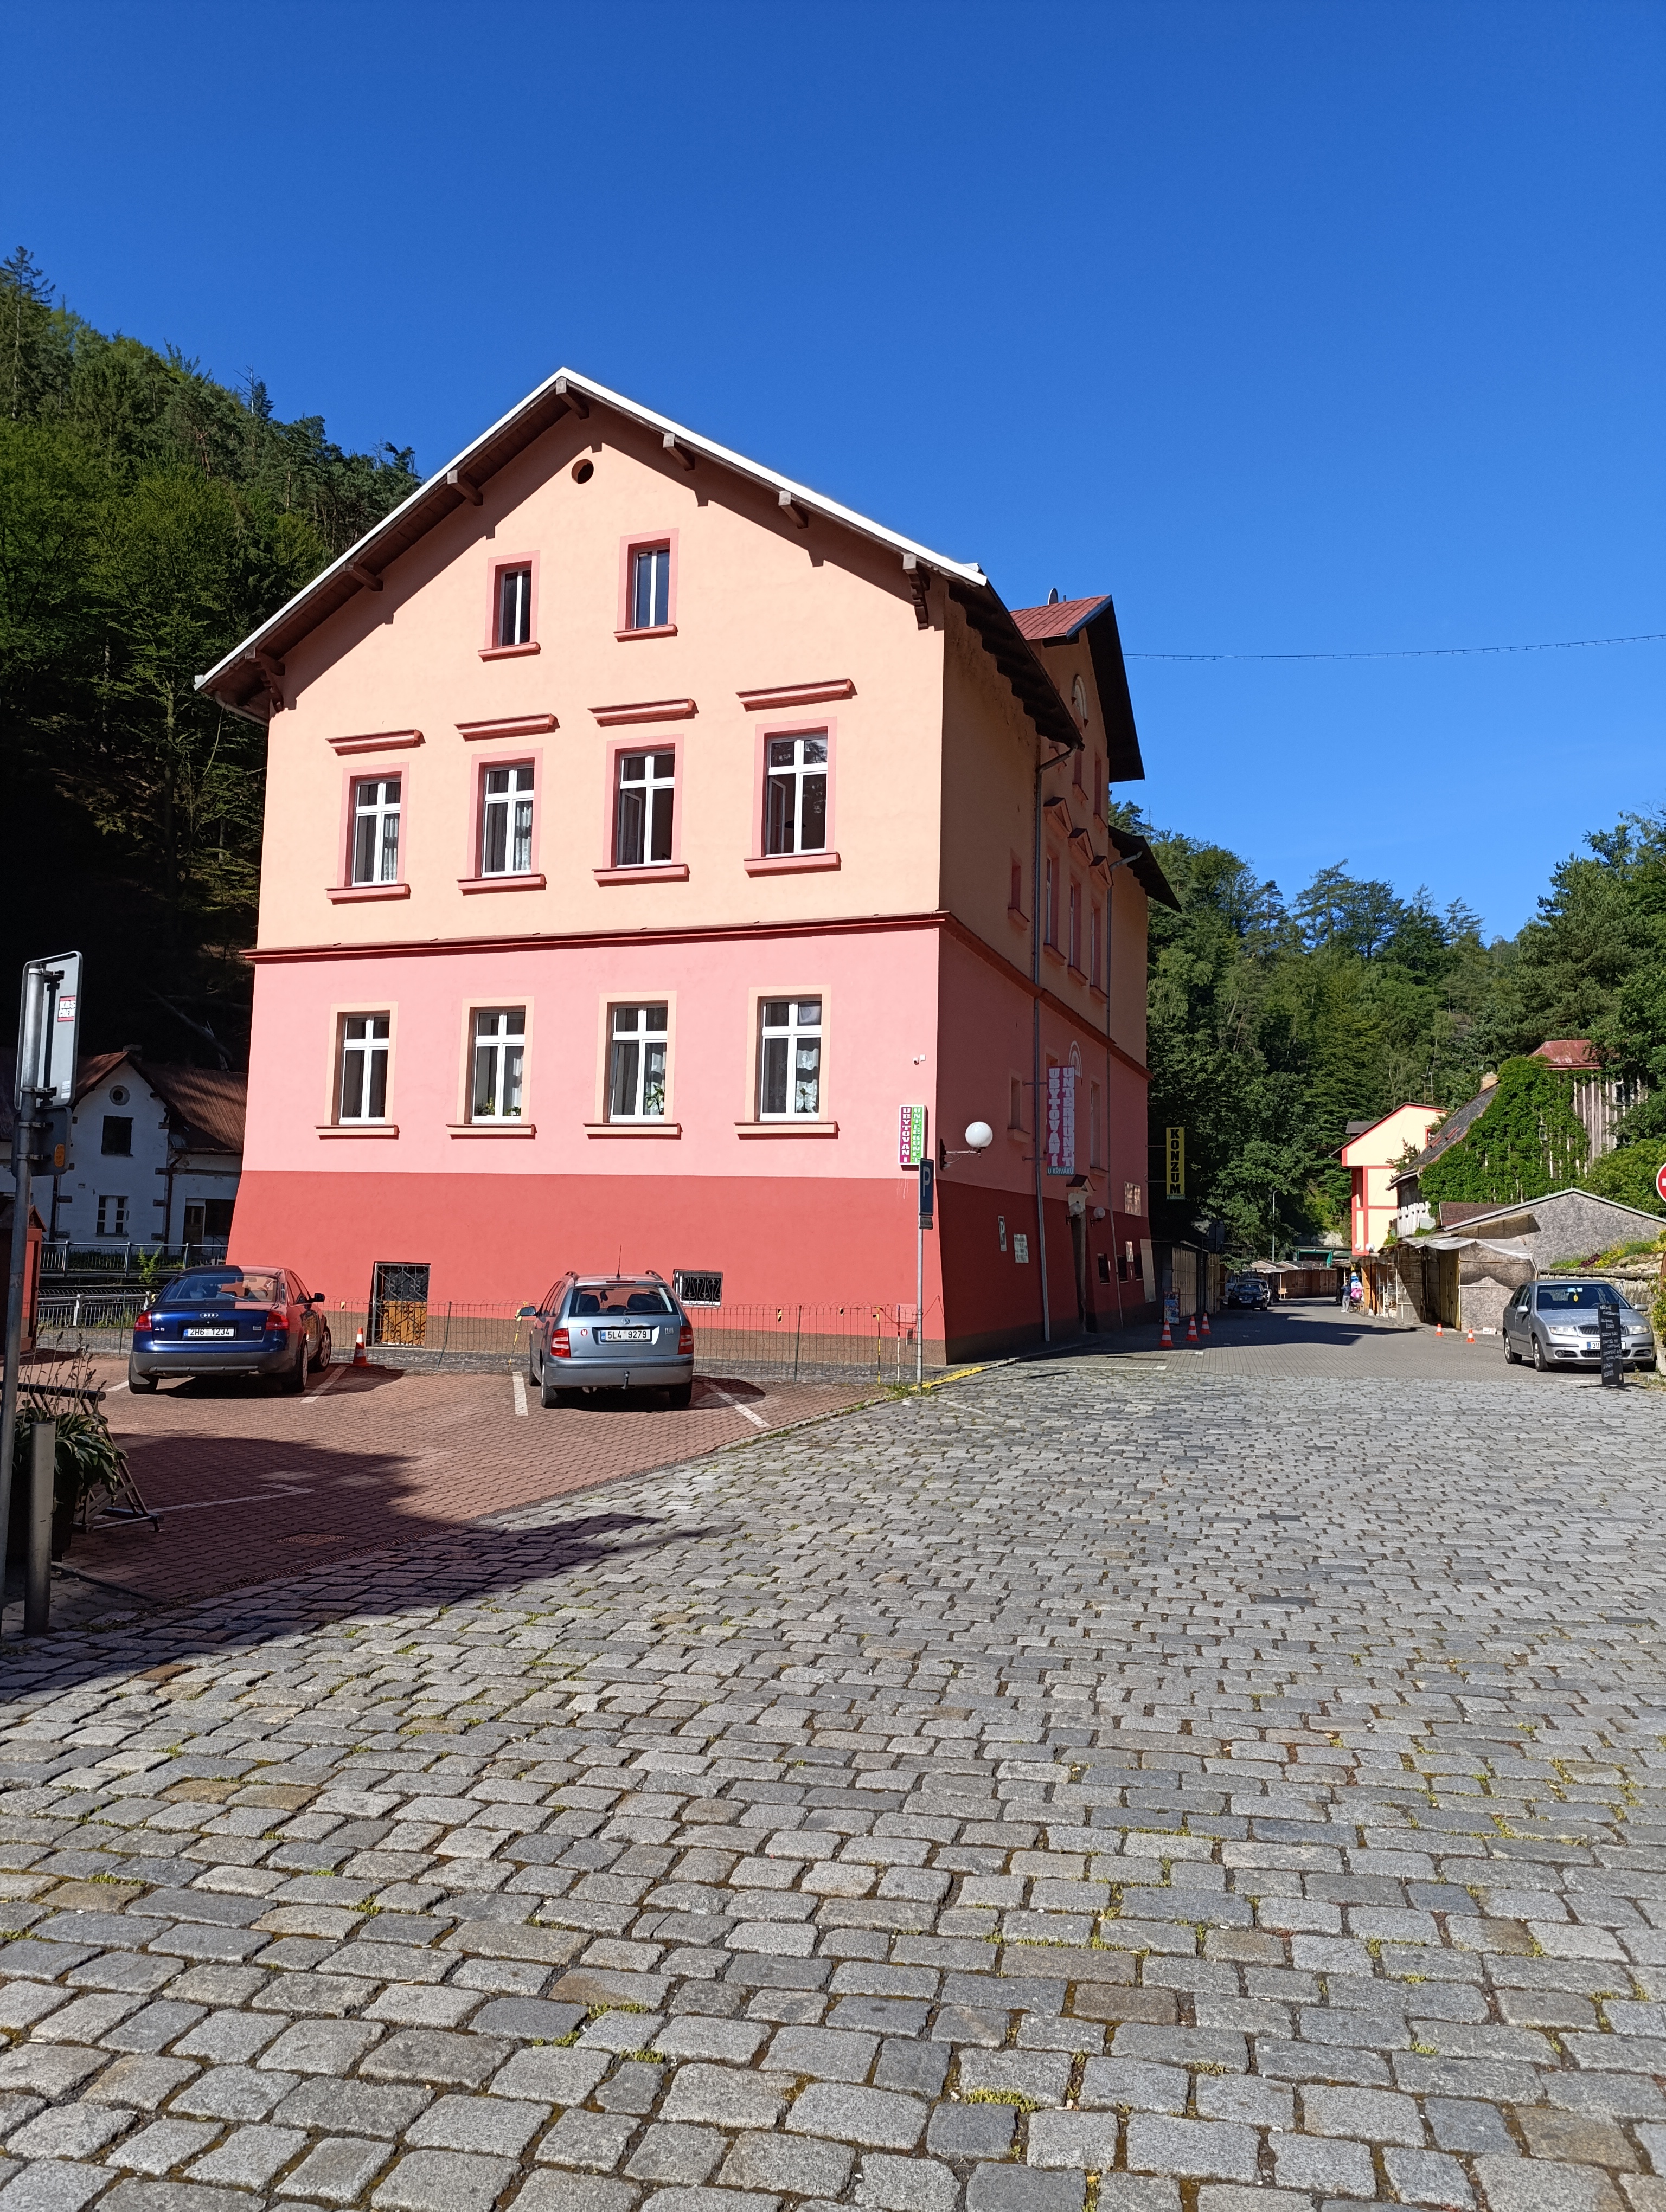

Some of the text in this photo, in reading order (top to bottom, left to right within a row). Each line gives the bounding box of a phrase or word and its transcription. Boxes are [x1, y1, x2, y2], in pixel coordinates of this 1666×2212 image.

[912, 1108, 921, 1162] UNTERKUNFT
[1048, 1068, 1060, 1166] UBYTOVÁNÍ
[1062, 1067, 1074, 1166] UNTERKUNFT
[922, 1166, 931, 1197] P
[1169, 1128, 1181, 1194] KONZUM
[1000, 1221, 1004, 1242] P
[628, 1330, 647, 1339] 9279
